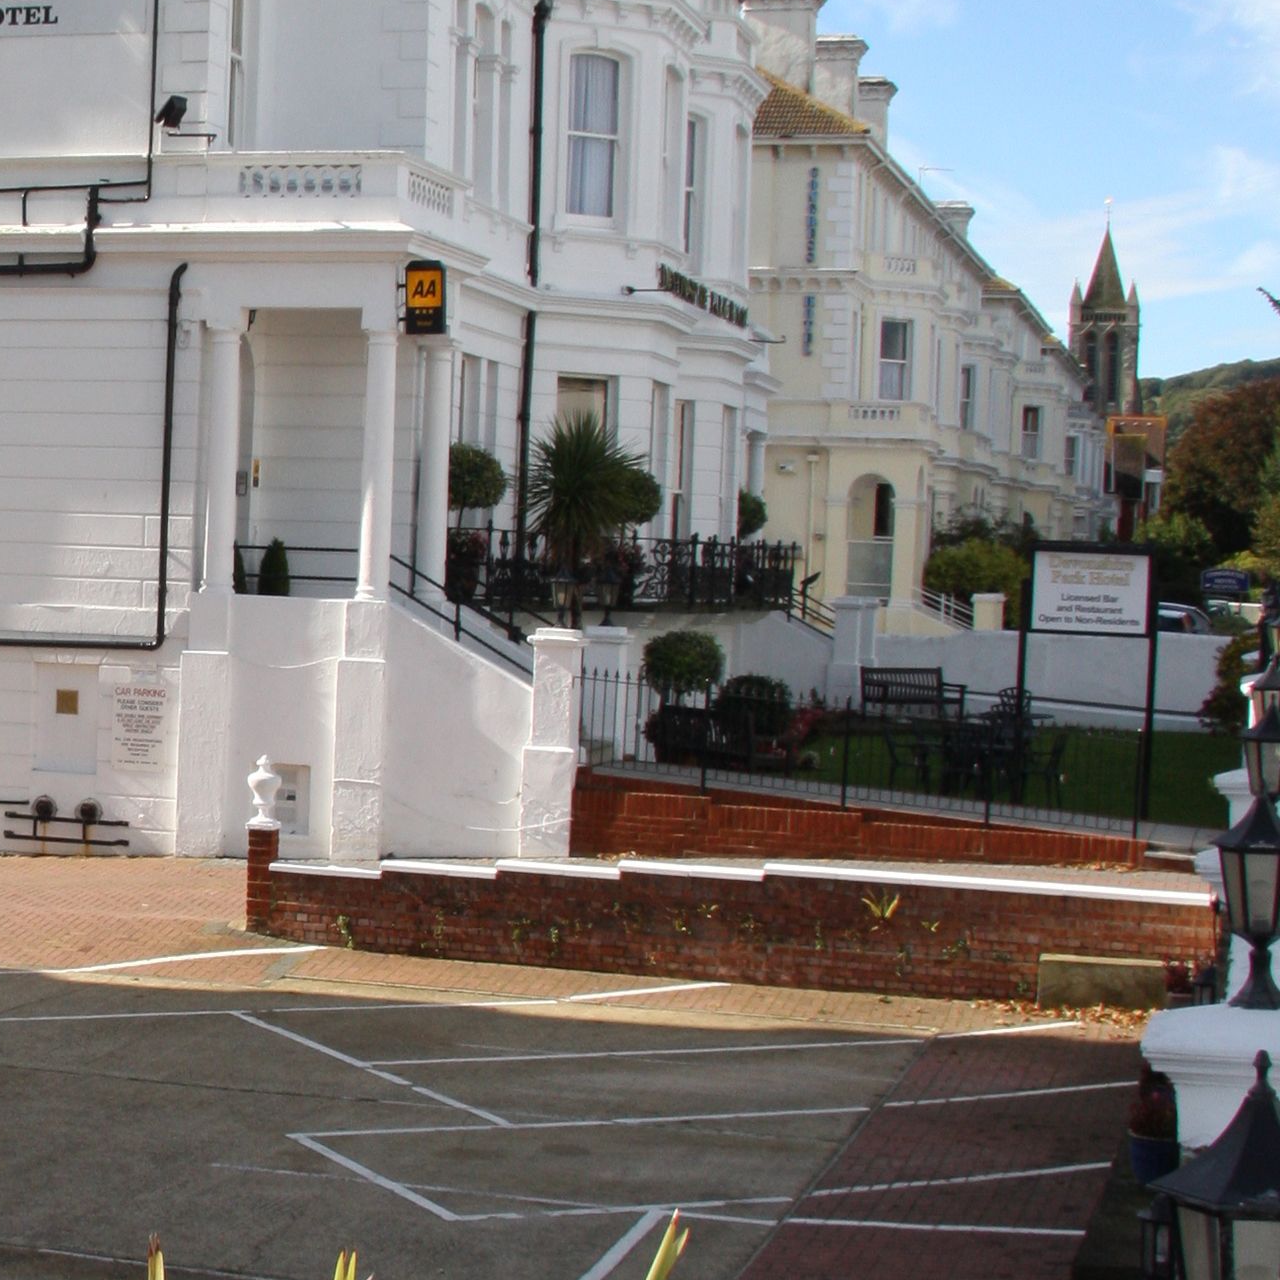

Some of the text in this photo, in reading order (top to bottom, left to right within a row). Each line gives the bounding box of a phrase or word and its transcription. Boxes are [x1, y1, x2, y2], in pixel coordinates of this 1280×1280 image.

[412, 279, 437, 298] AA
[1050, 570, 1131, 586] Park Hotel
[1060, 593, 1120, 603] Licensed Bar
[1056, 604, 1123, 614] and Restaurant
[1038, 614, 1141, 626] Open to Non-Residents
[114, 687, 166, 698] CAR PARKING
